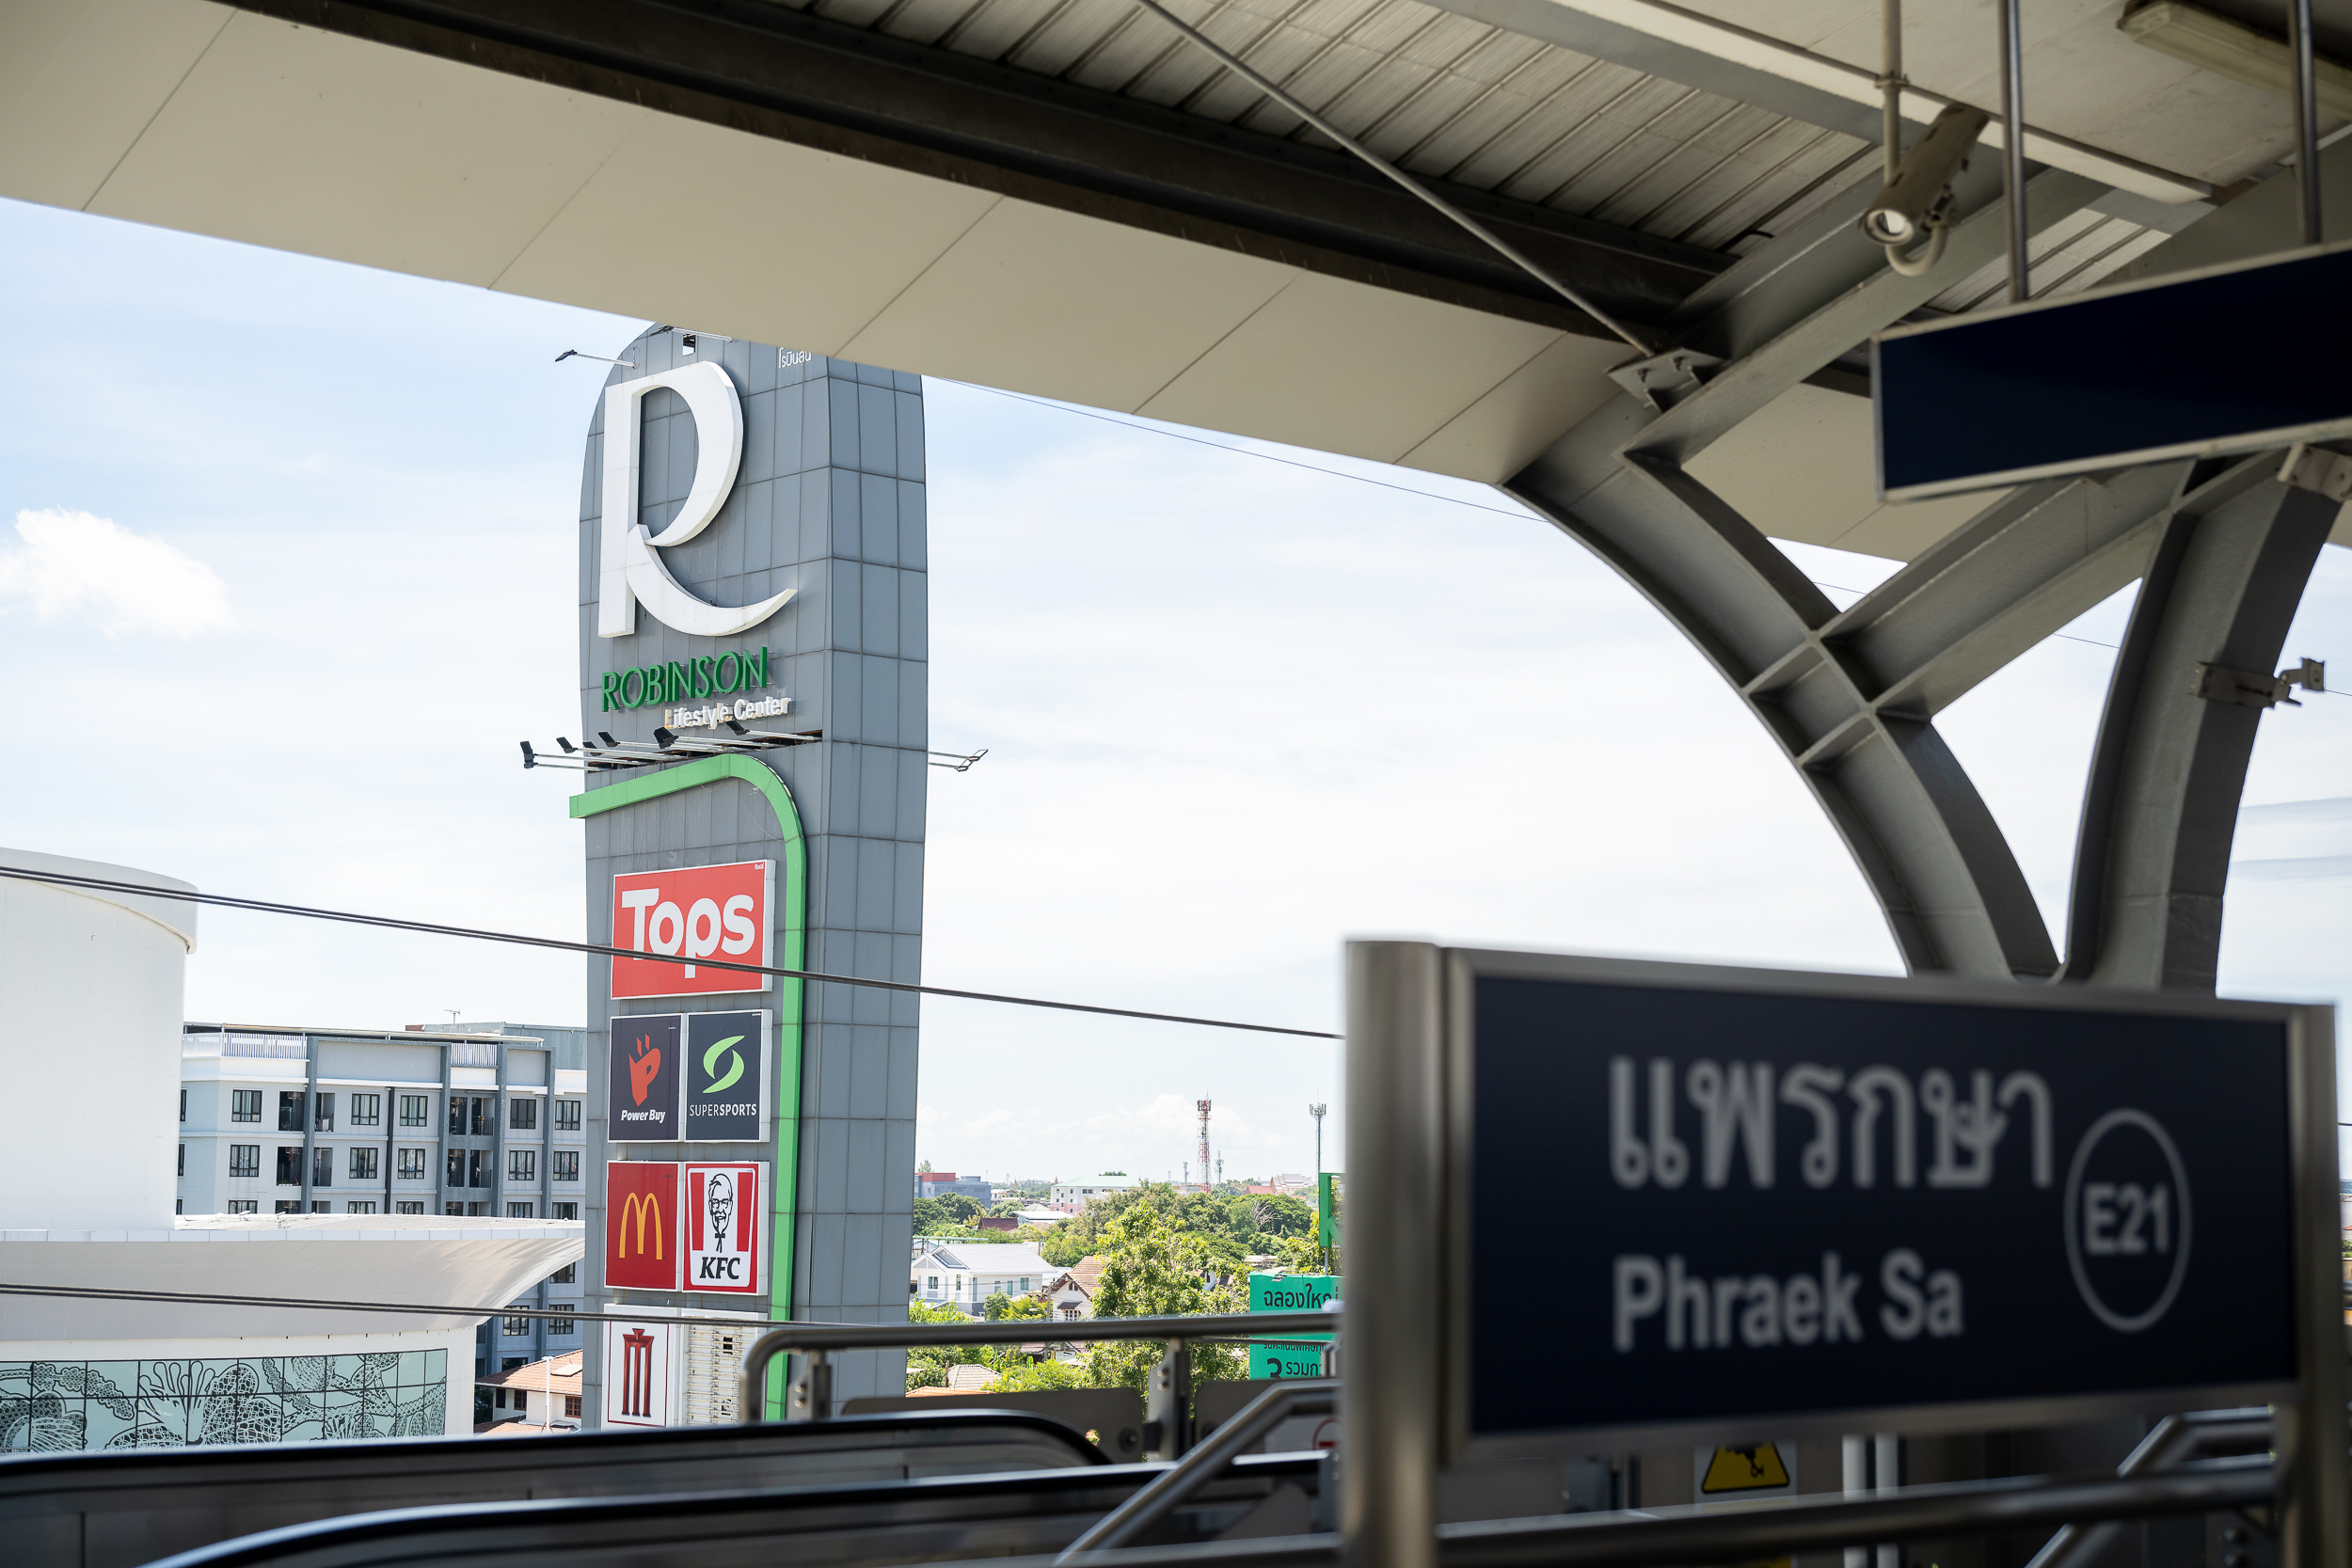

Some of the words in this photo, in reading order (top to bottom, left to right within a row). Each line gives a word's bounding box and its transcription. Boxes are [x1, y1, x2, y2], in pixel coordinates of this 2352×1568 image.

[601, 646, 768, 712] ROBINSON
[664, 703, 734, 730] Lifestyle
[734, 696, 792, 721] Center
[622, 888, 755, 979] Tops
[621, 1109, 649, 1121] Power
[649, 1109, 666, 1124] Buy
[690, 1103, 757, 1117] SUPERSPORTS
[1607, 1054, 2055, 1190] แพรกษา
[2082, 1181, 2169, 1254] E21
[699, 1257, 741, 1280] KFC
[1613, 1251, 1864, 1353] Phraek
[1878, 1248, 1964, 1338] Sa
